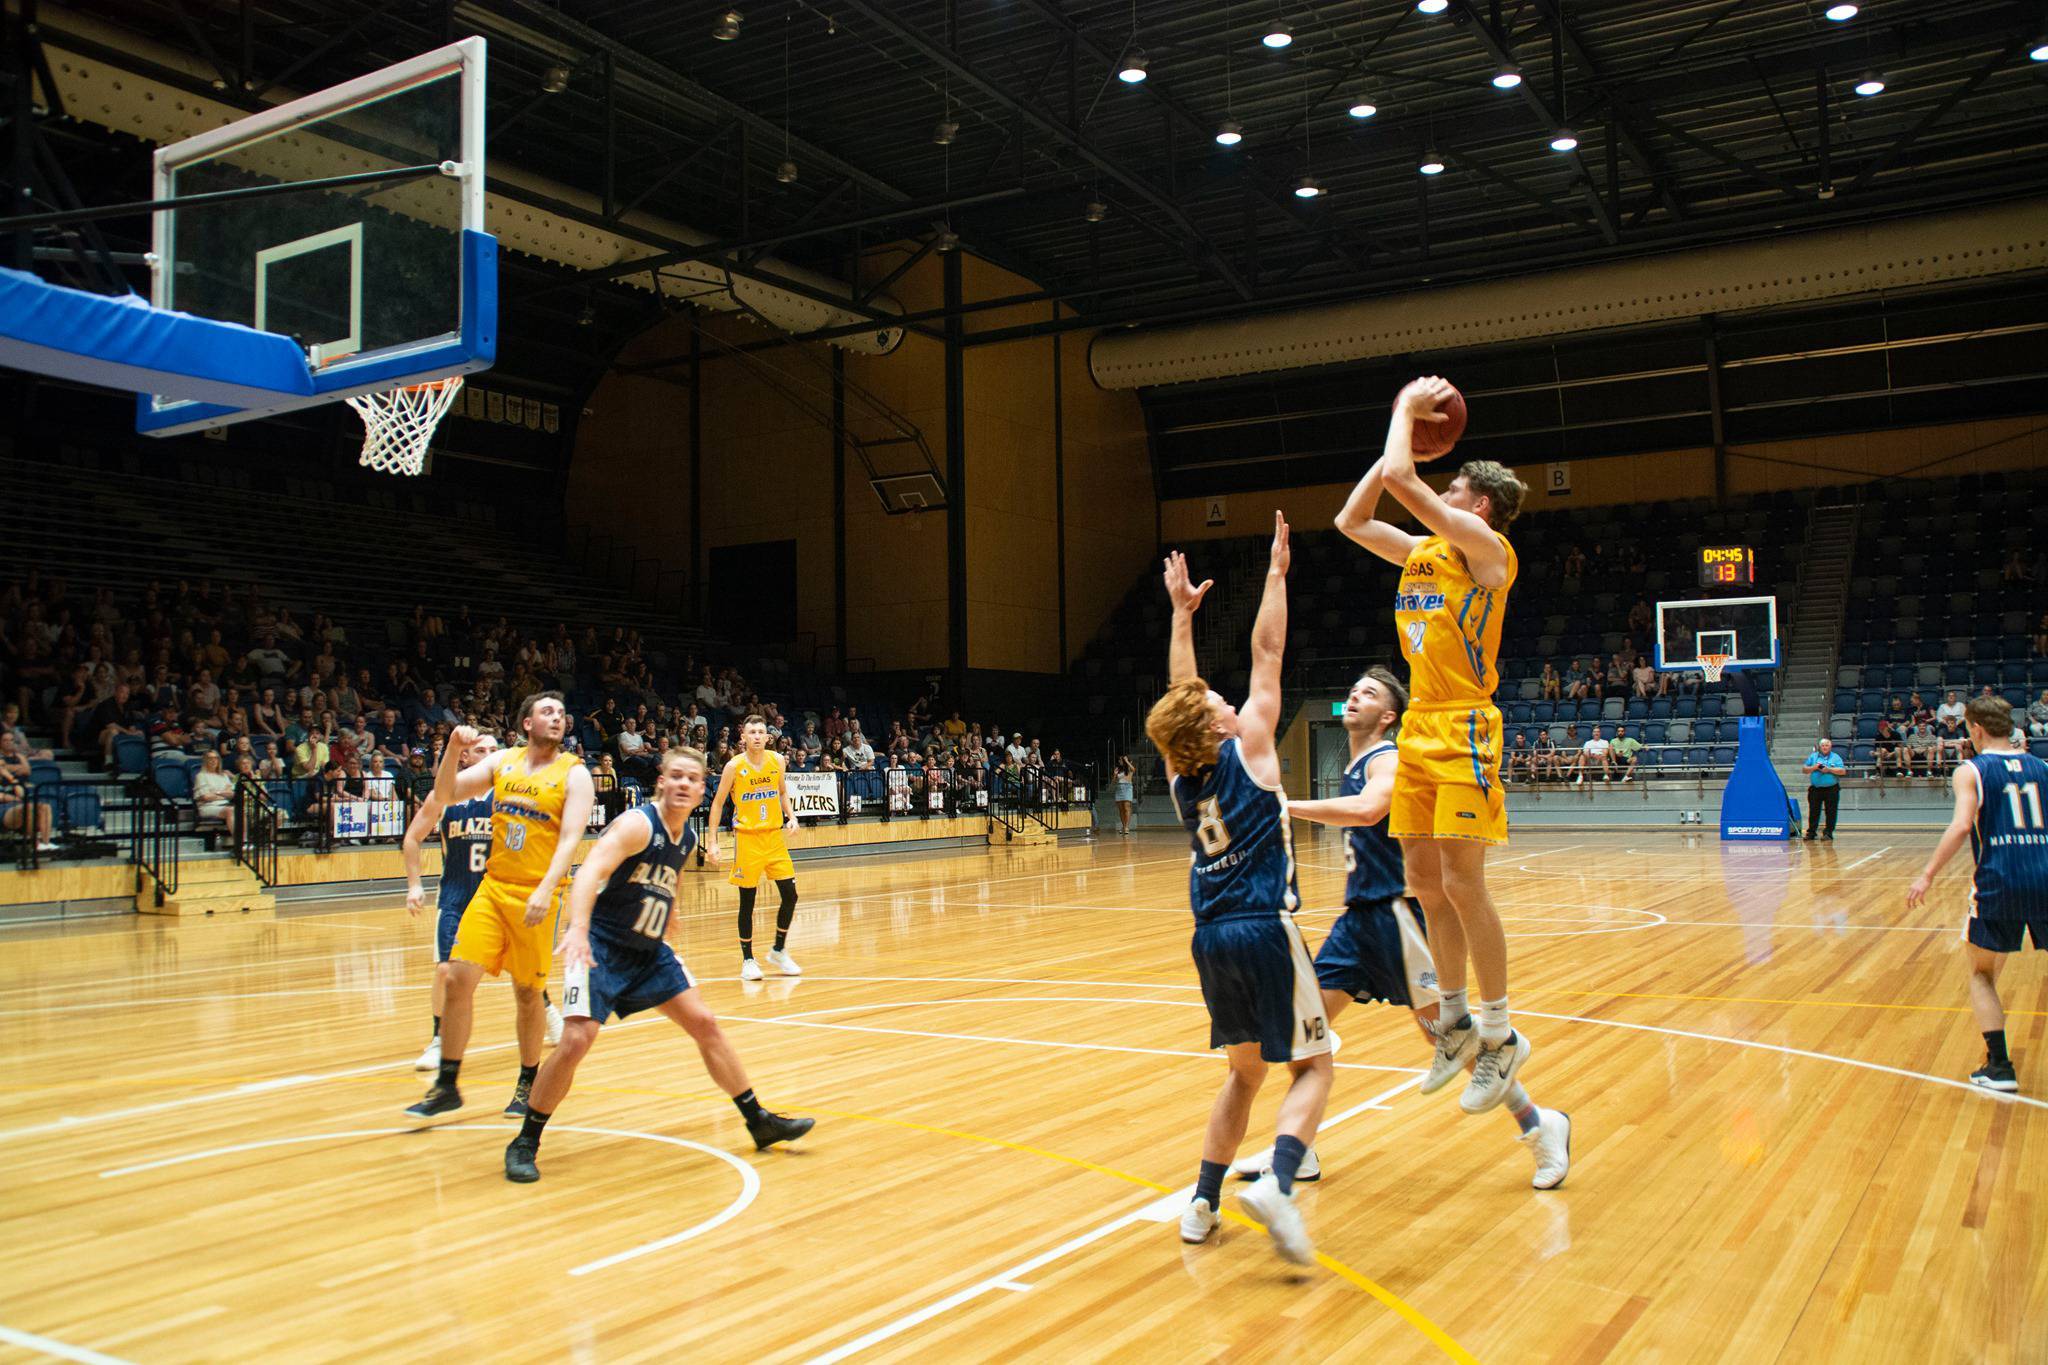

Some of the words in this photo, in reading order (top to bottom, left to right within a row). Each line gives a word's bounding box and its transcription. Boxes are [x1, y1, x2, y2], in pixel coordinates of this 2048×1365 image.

[1554, 470, 1565, 487] B
[1210, 503, 1221, 519] A
[1703, 547, 1743, 563] 04:45
[1405, 561, 1434, 577] LGAS
[1718, 563, 1736, 582] 13
[504, 782, 539, 797] ELGAS
[750, 776, 771, 786] ELGAS
[2002, 782, 2045, 829] 11
[448, 817, 493, 840] BLAZE
[505, 822, 527, 851] 13
[469, 843, 487, 873] 6
[631, 896, 669, 940] 10
